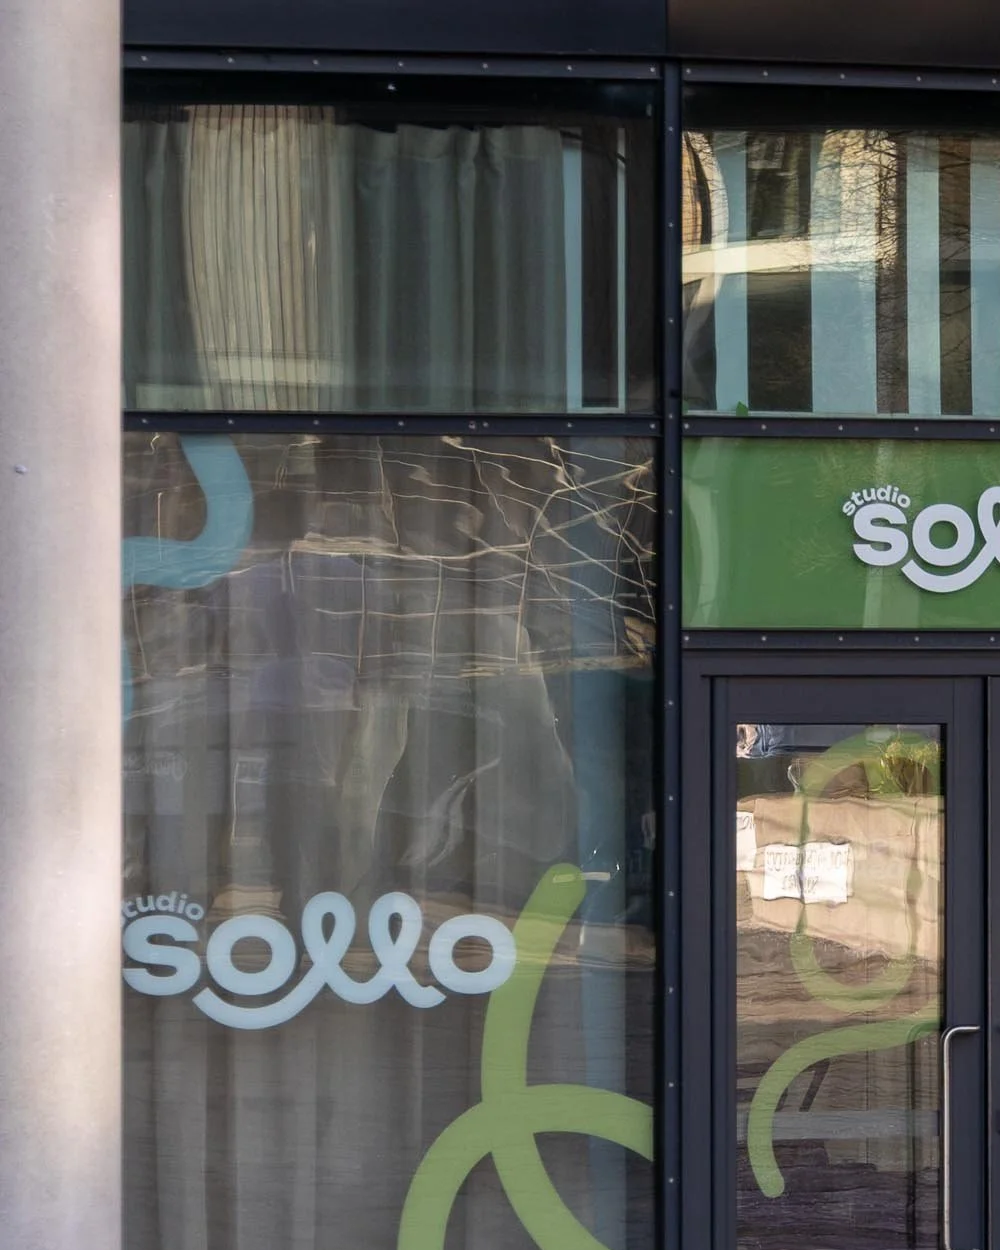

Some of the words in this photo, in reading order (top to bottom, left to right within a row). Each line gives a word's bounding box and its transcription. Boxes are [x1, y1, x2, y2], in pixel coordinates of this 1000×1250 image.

[842, 485, 911, 517] studio
[121, 891, 204, 923] tudio
[122, 891, 517, 1030] sollo
